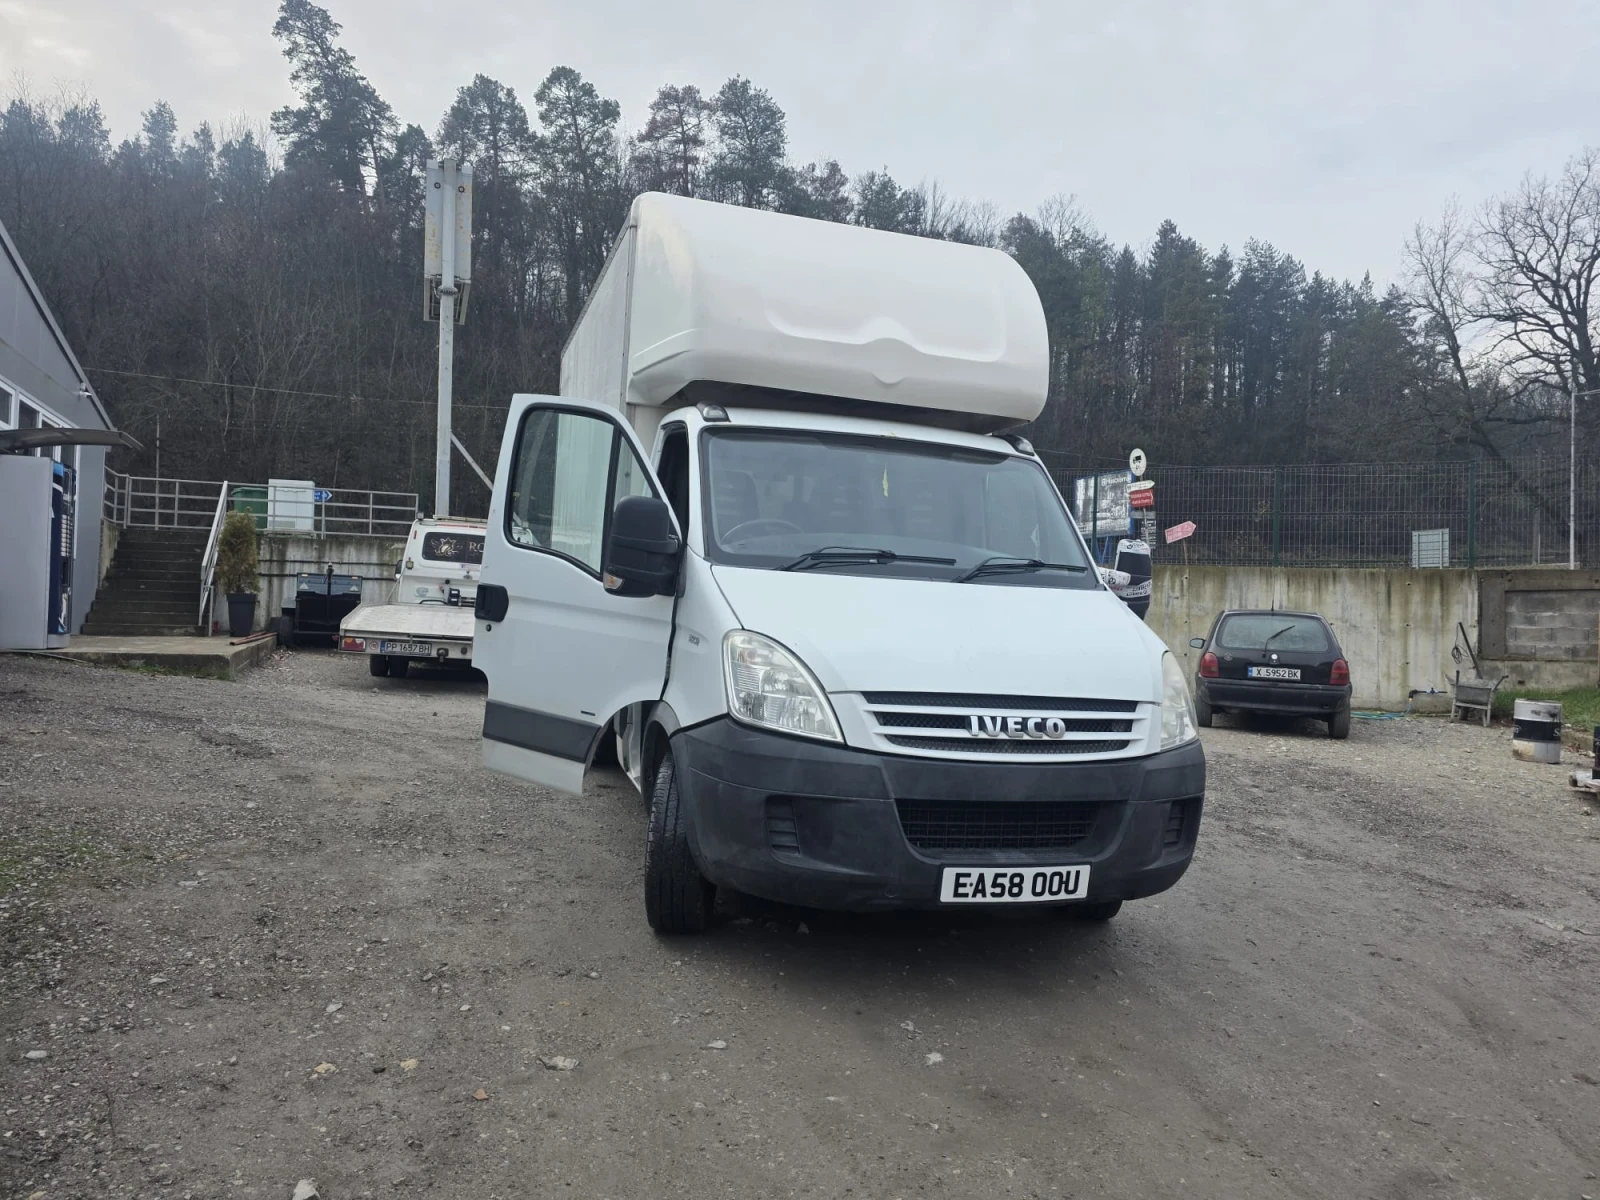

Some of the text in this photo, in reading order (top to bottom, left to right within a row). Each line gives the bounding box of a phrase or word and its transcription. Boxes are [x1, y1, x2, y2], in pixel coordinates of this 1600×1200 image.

[1256, 668, 1299, 679] X 5952 BK
[967, 715, 1066, 739] IVECO
[952, 872, 1025, 898] EA58
